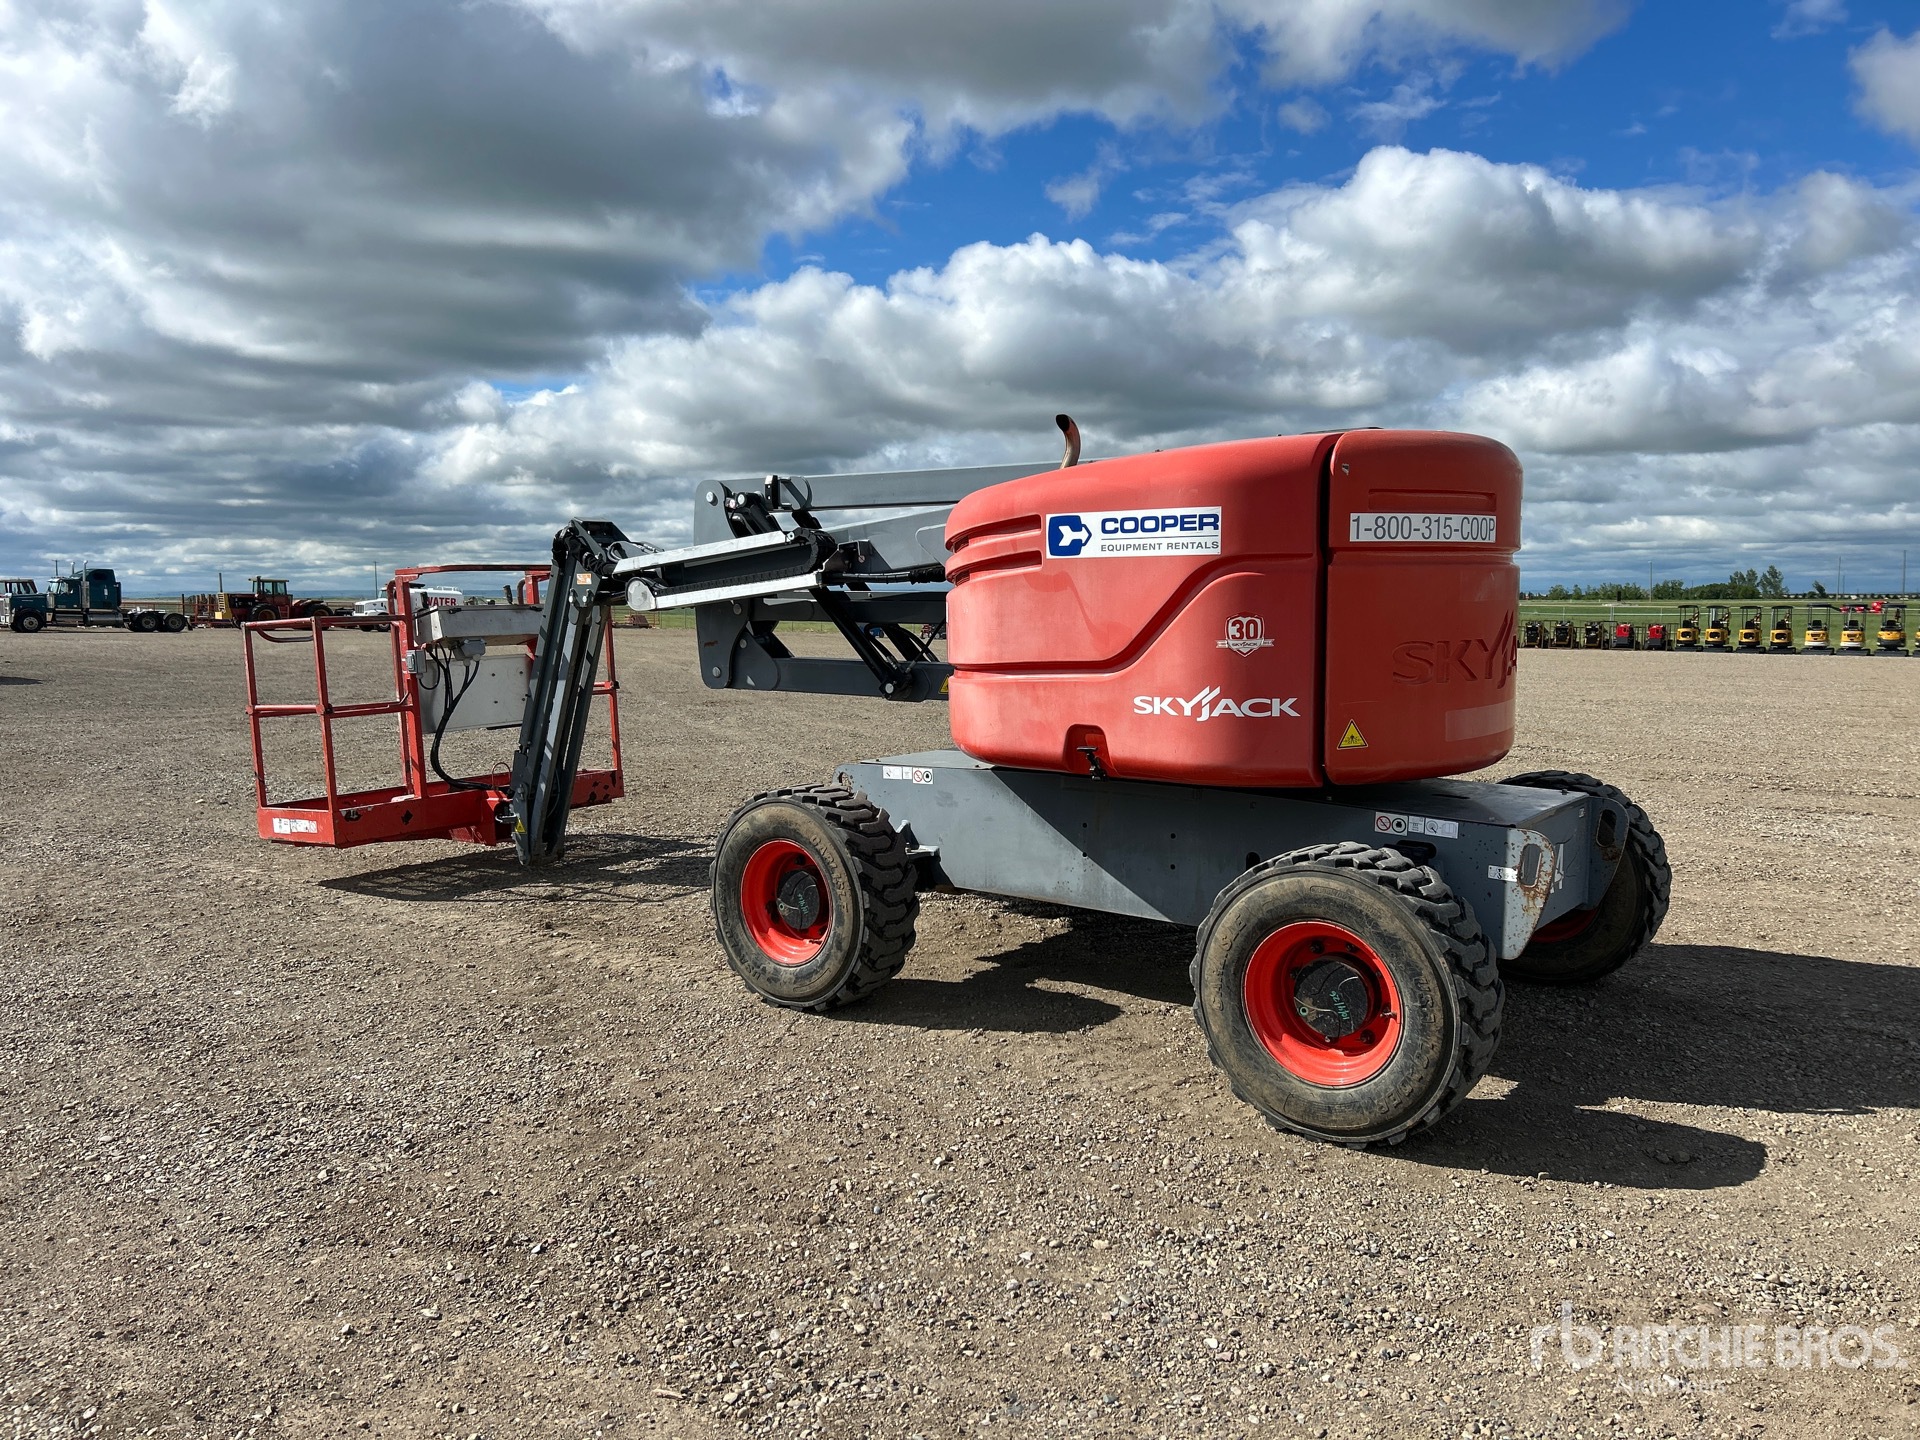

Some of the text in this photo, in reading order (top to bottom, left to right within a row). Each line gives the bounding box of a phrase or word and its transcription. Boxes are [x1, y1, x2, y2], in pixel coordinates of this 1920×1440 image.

[1101, 513, 1220, 535] COOPER
[1351, 515, 1496, 541] 1-800-315-COOP
[1101, 540, 1220, 552] EQUIPMENT RENTALS
[426, 597, 457, 607] WATER
[1231, 619, 1258, 640] 30
[1133, 685, 1301, 722] SKYJACK
